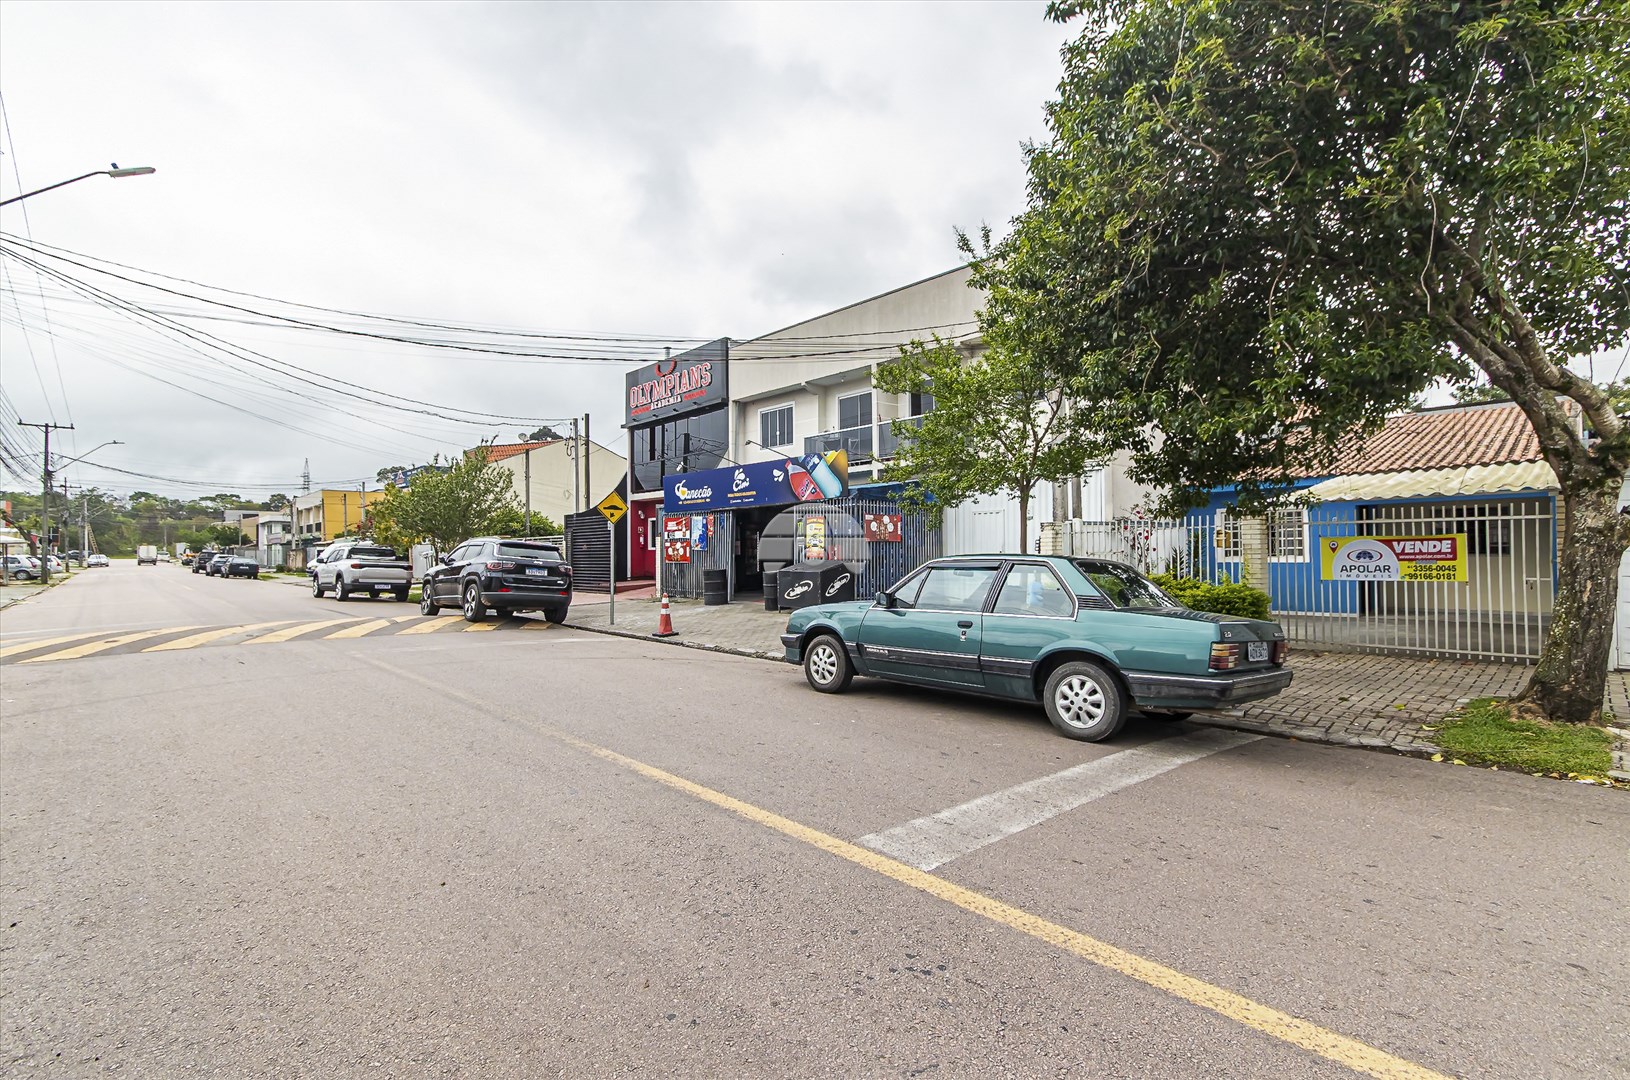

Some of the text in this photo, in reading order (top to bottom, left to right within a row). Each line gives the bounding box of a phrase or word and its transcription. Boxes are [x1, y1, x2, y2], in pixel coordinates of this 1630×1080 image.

[630, 362, 712, 408] OLYMPIANS
[650, 395, 682, 410] ACADEMIA
[675, 480, 712, 500] Canecão
[1392, 541, 1452, 553] VENDE
[1340, 565, 1392, 573] APOLAR
